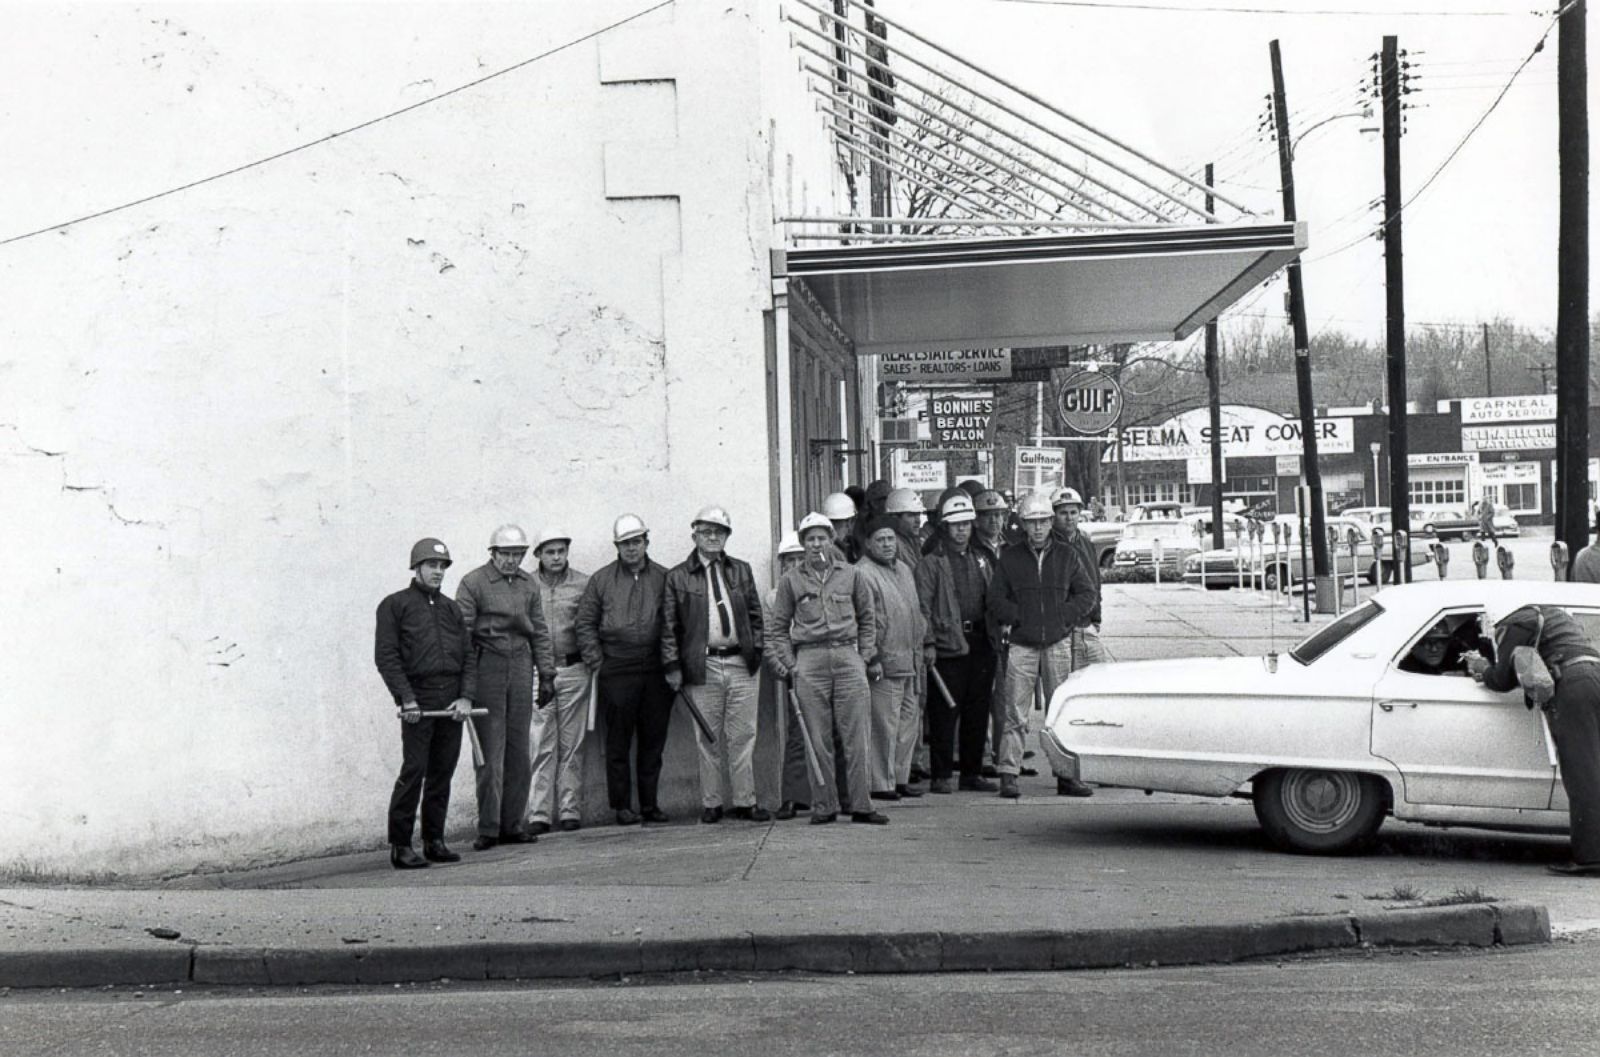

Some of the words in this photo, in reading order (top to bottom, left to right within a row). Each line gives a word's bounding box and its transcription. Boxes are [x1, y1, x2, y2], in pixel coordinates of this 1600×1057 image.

[883, 363, 911, 374] SALES
[919, 362, 967, 374] REALTORS
[973, 361, 1001, 372] LOANS
[933, 400, 993, 414] BONNIE'S
[1064, 388, 1117, 413] GULF
[1472, 399, 1549, 410] CARNEAL
[1470, 410, 1502, 419] AUTO
[1507, 408, 1553, 418] SERVICE
[936, 416, 990, 429] BEAUTY
[942, 429, 985, 441] SALON
[1121, 428, 1189, 447] SELMA
[1199, 425, 1255, 444] SEAT
[1426, 455, 1475, 463] ENTRANCE
